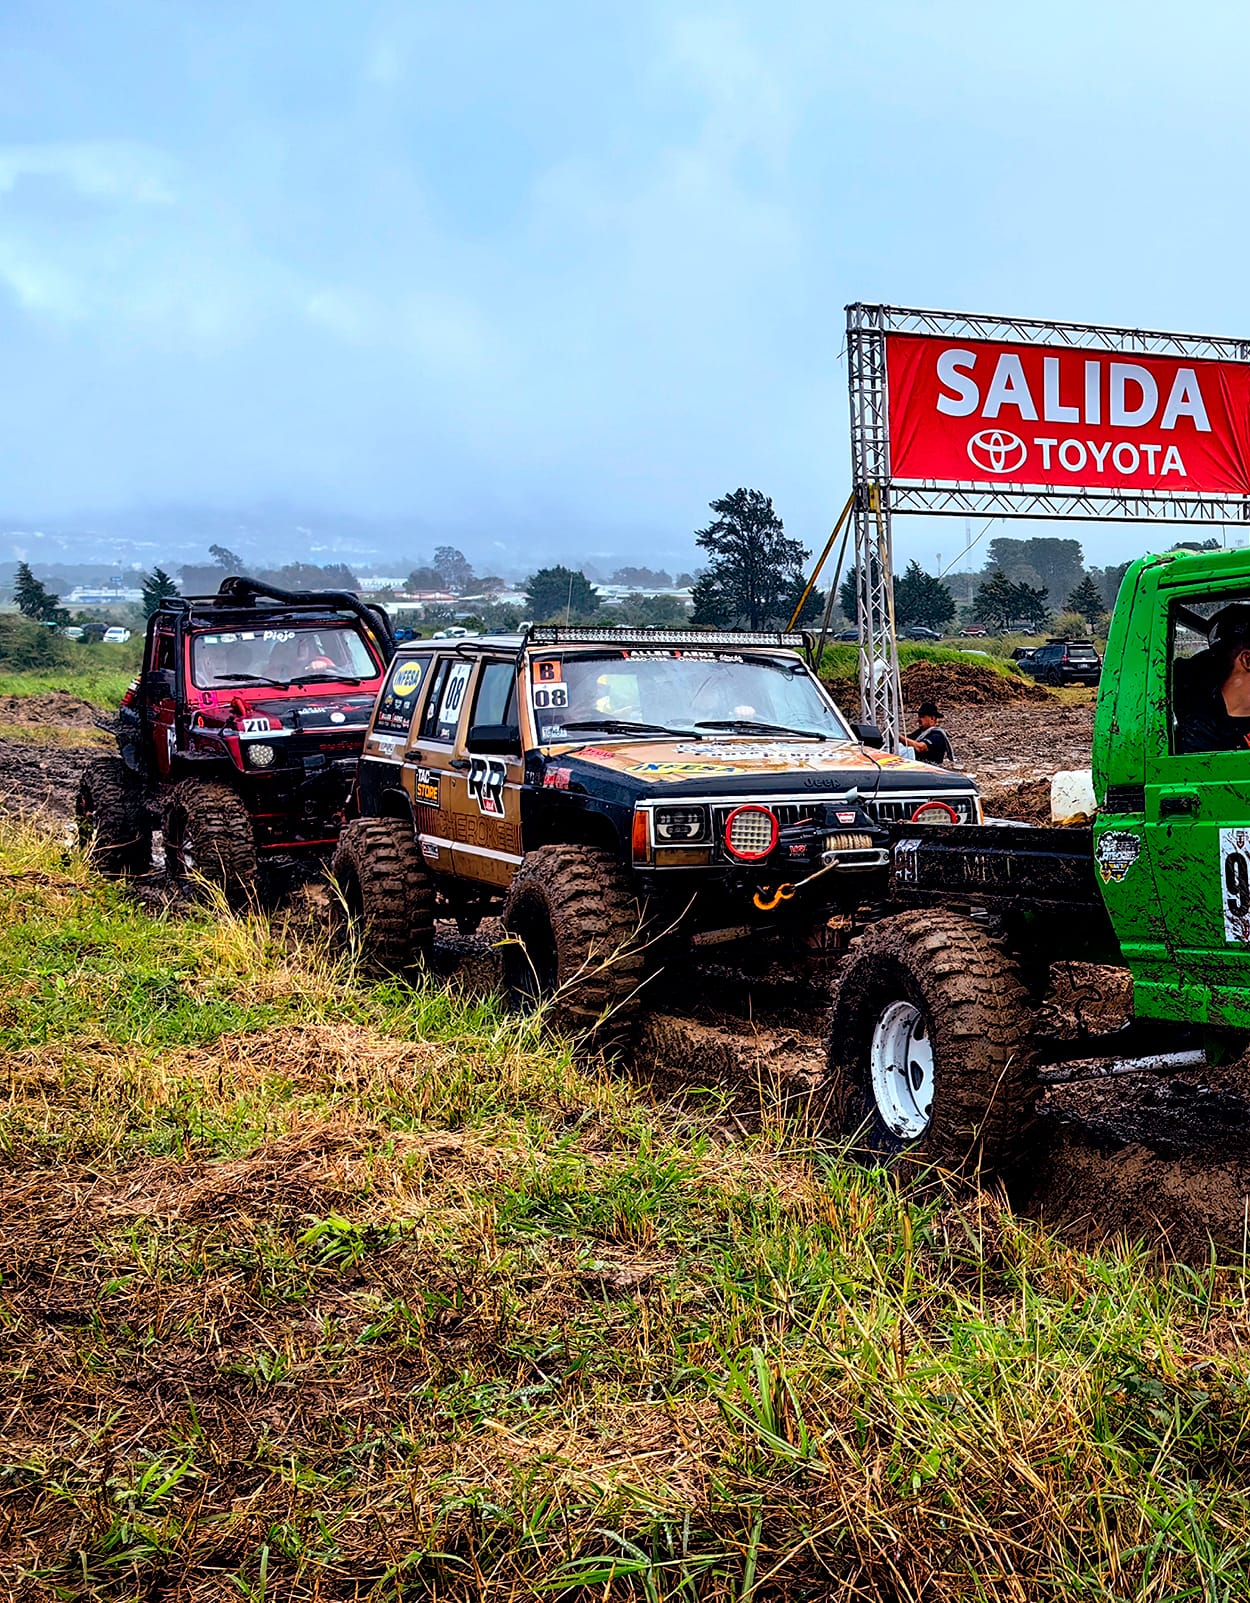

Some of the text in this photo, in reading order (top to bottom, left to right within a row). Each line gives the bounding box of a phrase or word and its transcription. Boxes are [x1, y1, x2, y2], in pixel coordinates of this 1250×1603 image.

[936, 348, 1213, 433] SALIDA
[1034, 437, 1188, 478] TOYOTA
[539, 663, 554, 680] B
[445, 676, 465, 710] 08
[535, 689, 567, 708] 08
[416, 768, 430, 784] TAC
[803, 776, 842, 790] Jeep
[416, 783, 438, 800] STORE
